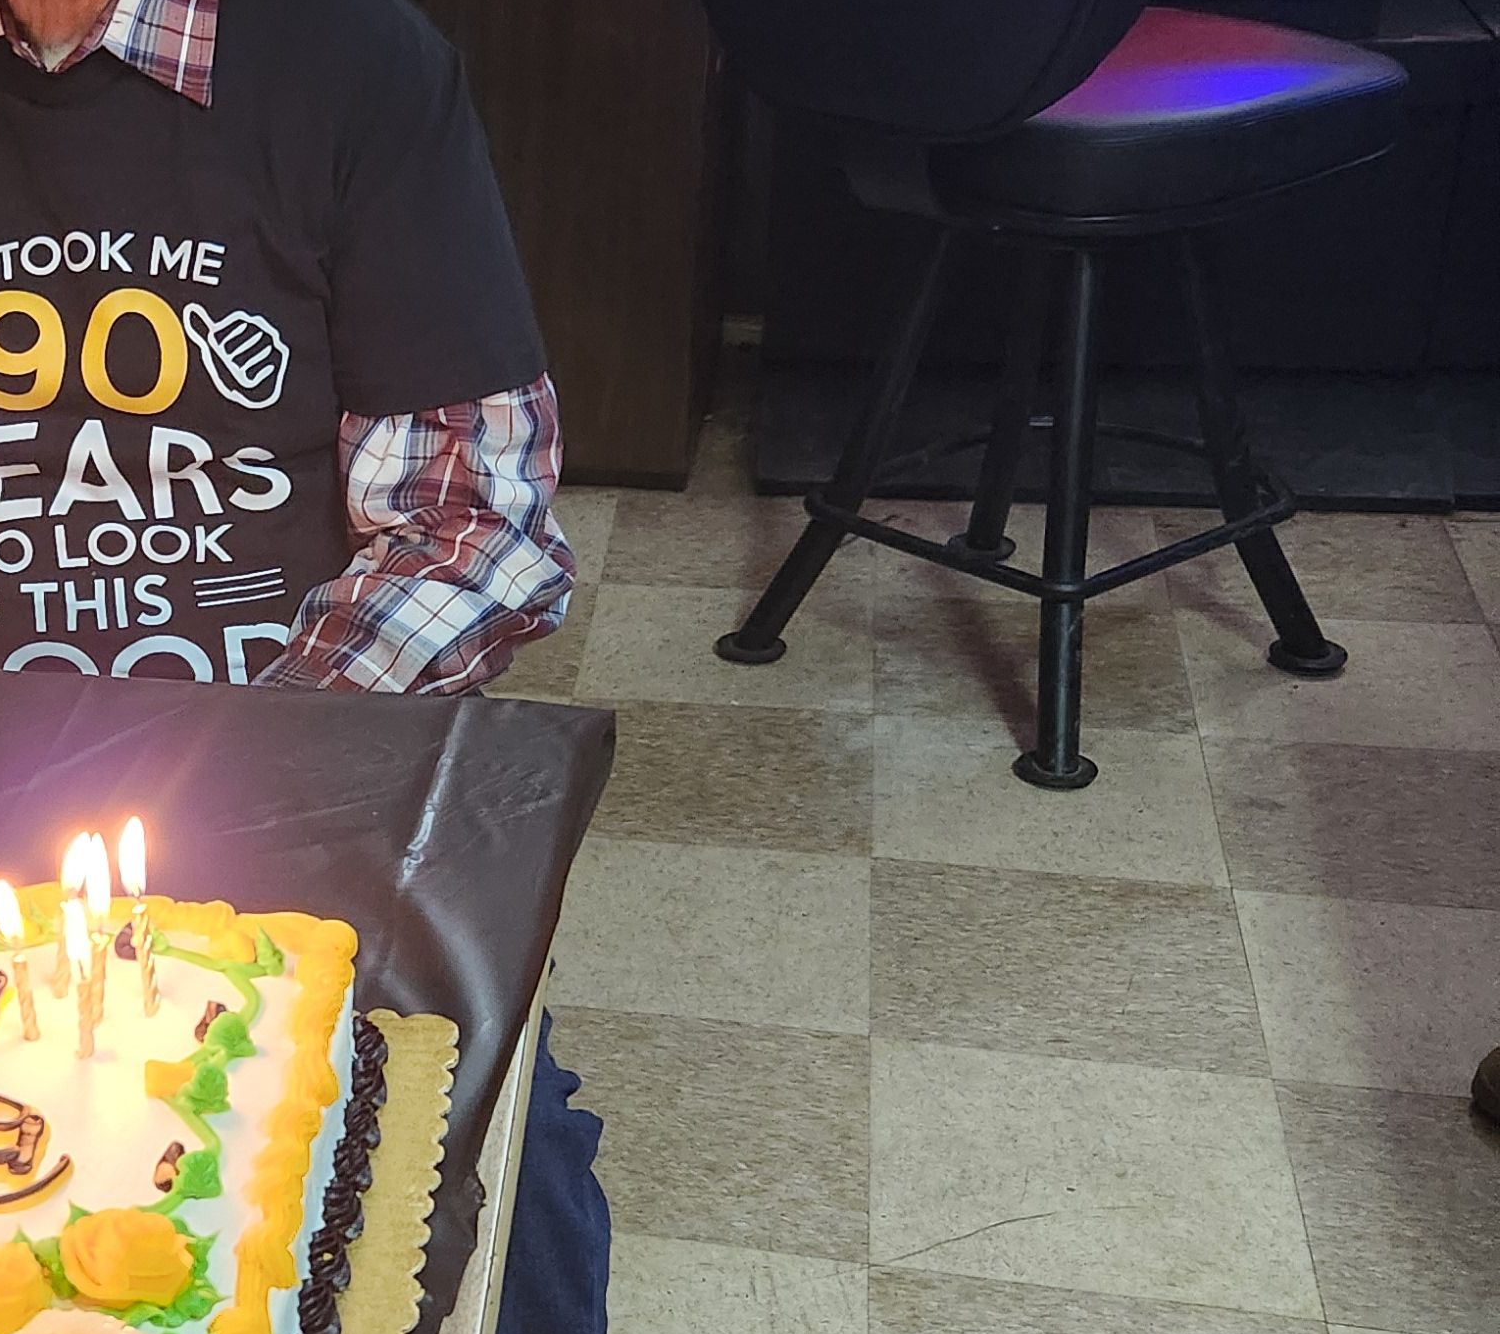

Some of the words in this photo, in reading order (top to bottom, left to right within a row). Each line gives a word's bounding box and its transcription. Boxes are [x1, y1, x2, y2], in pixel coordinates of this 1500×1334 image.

[149, 235, 226, 286] ME
[55, 522, 233, 569] LOOK
[20, 574, 173, 633] THIS
